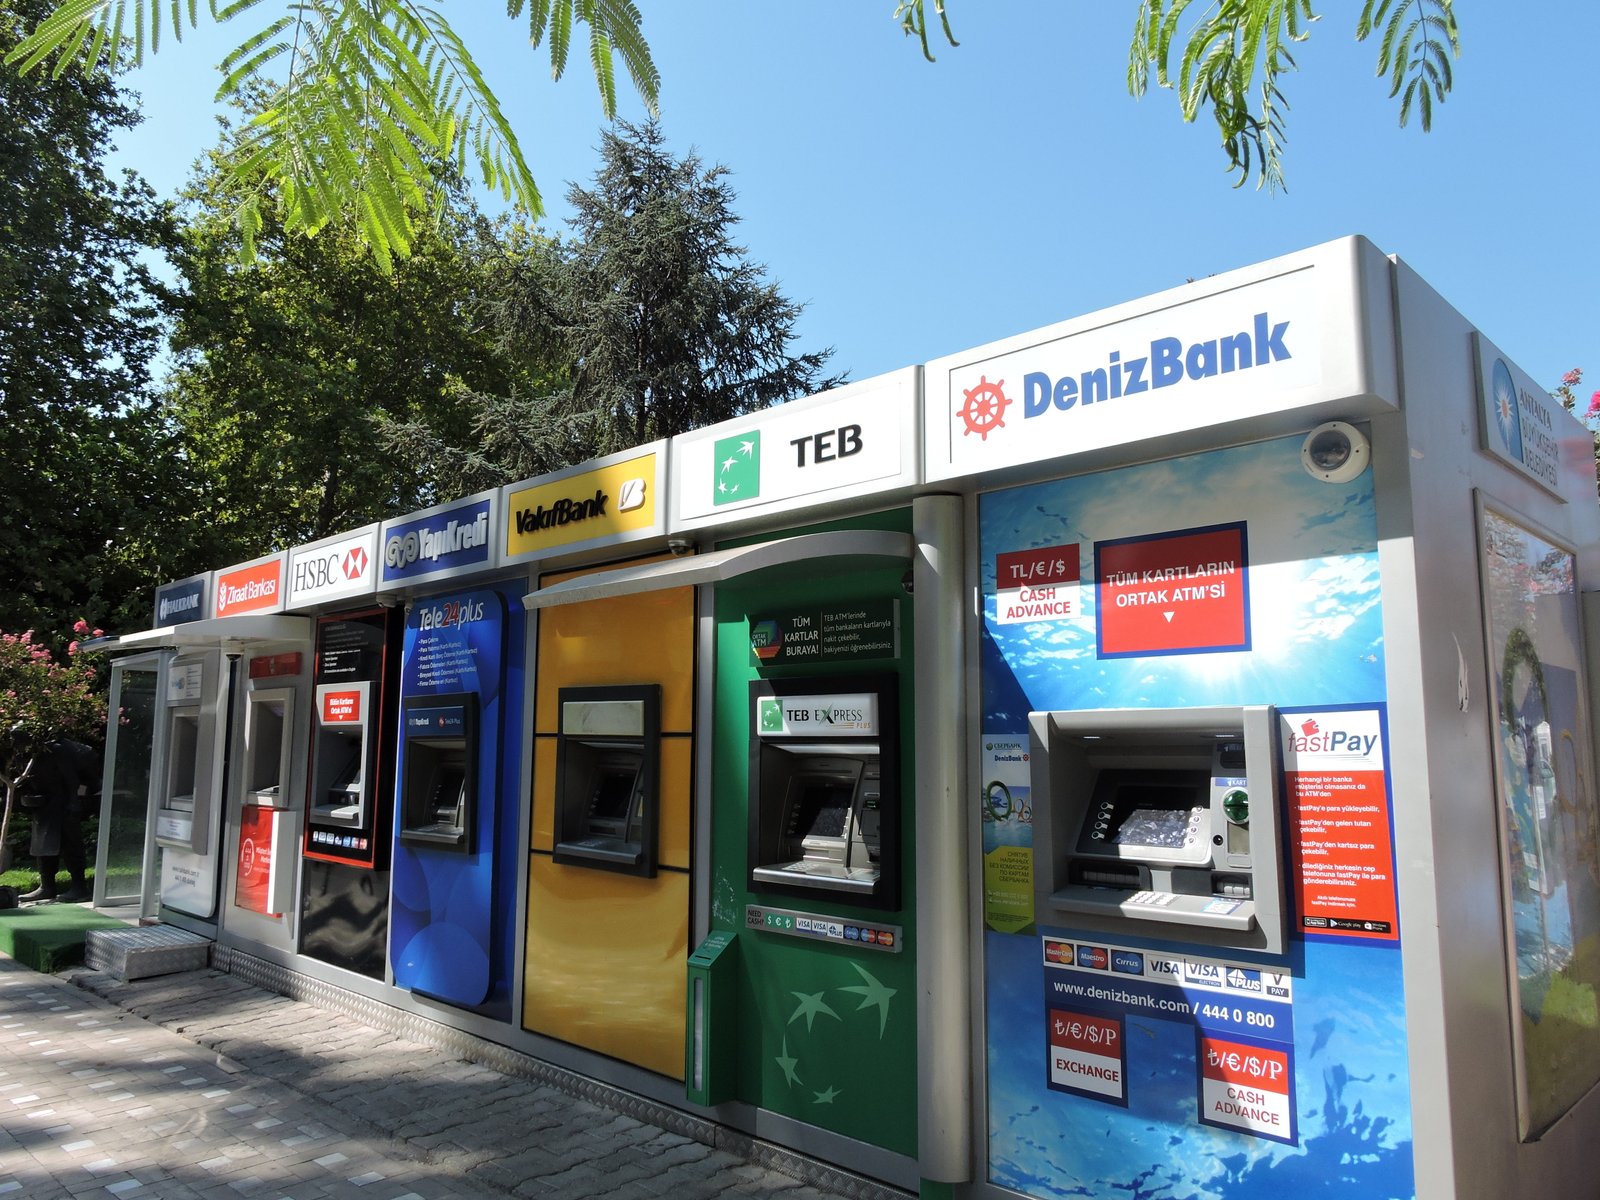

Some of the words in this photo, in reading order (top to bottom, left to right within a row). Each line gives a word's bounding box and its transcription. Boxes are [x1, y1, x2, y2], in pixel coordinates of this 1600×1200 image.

[1023, 311, 1292, 419] DenizBank
[790, 423, 863, 468] TEB
[515, 490, 610, 534] VakıfBank
[293, 554, 339, 592] HSBC
[1106, 571, 1138, 587] TÜM
[1142, 561, 1235, 583] KARTLARIN
[227, 583, 248, 604] Ziraat
[248, 577, 275, 599] Bankası
[1019, 588, 1056, 603] CASH
[1116, 590, 1168, 607] ORTAK
[1172, 584, 1225, 602] ATM'Sİ
[419, 599, 484, 631] Tele24plus
[1006, 602, 1071, 619] ADVANCE
[792, 616, 811, 628] TÜM
[752, 639, 767, 647] ATM
[784, 630, 819, 642] KARTLAR
[786, 644, 819, 656] BURAYA!
[787, 710, 810, 722] TEB
[815, 704, 863, 724] EXPRESS
[1288, 731, 1377, 755] fastPay
[748, 910, 762, 918] NEED
[1046, 949, 1073, 958] MasterCard
[1081, 954, 1105, 962] Maestro
[1116, 958, 1139, 967] Cirrus
[1150, 960, 1180, 975] VISA
[1190, 964, 1219, 978] VISA
[1236, 979, 1261, 991] PLUS
[1272, 973, 1283, 986] V
[1271, 988, 1285, 996] PAY
[1053, 981, 1190, 1014] www.denizbank.com
[1202, 1004, 1229, 1020] 444
[1233, 1009, 1242, 1023] 0
[1246, 1011, 1275, 1028] 800
[1056, 1058, 1119, 1083] EXCHANGE
[1227, 1087, 1265, 1106] CASH
[1215, 1100, 1280, 1126] ADVANCE
